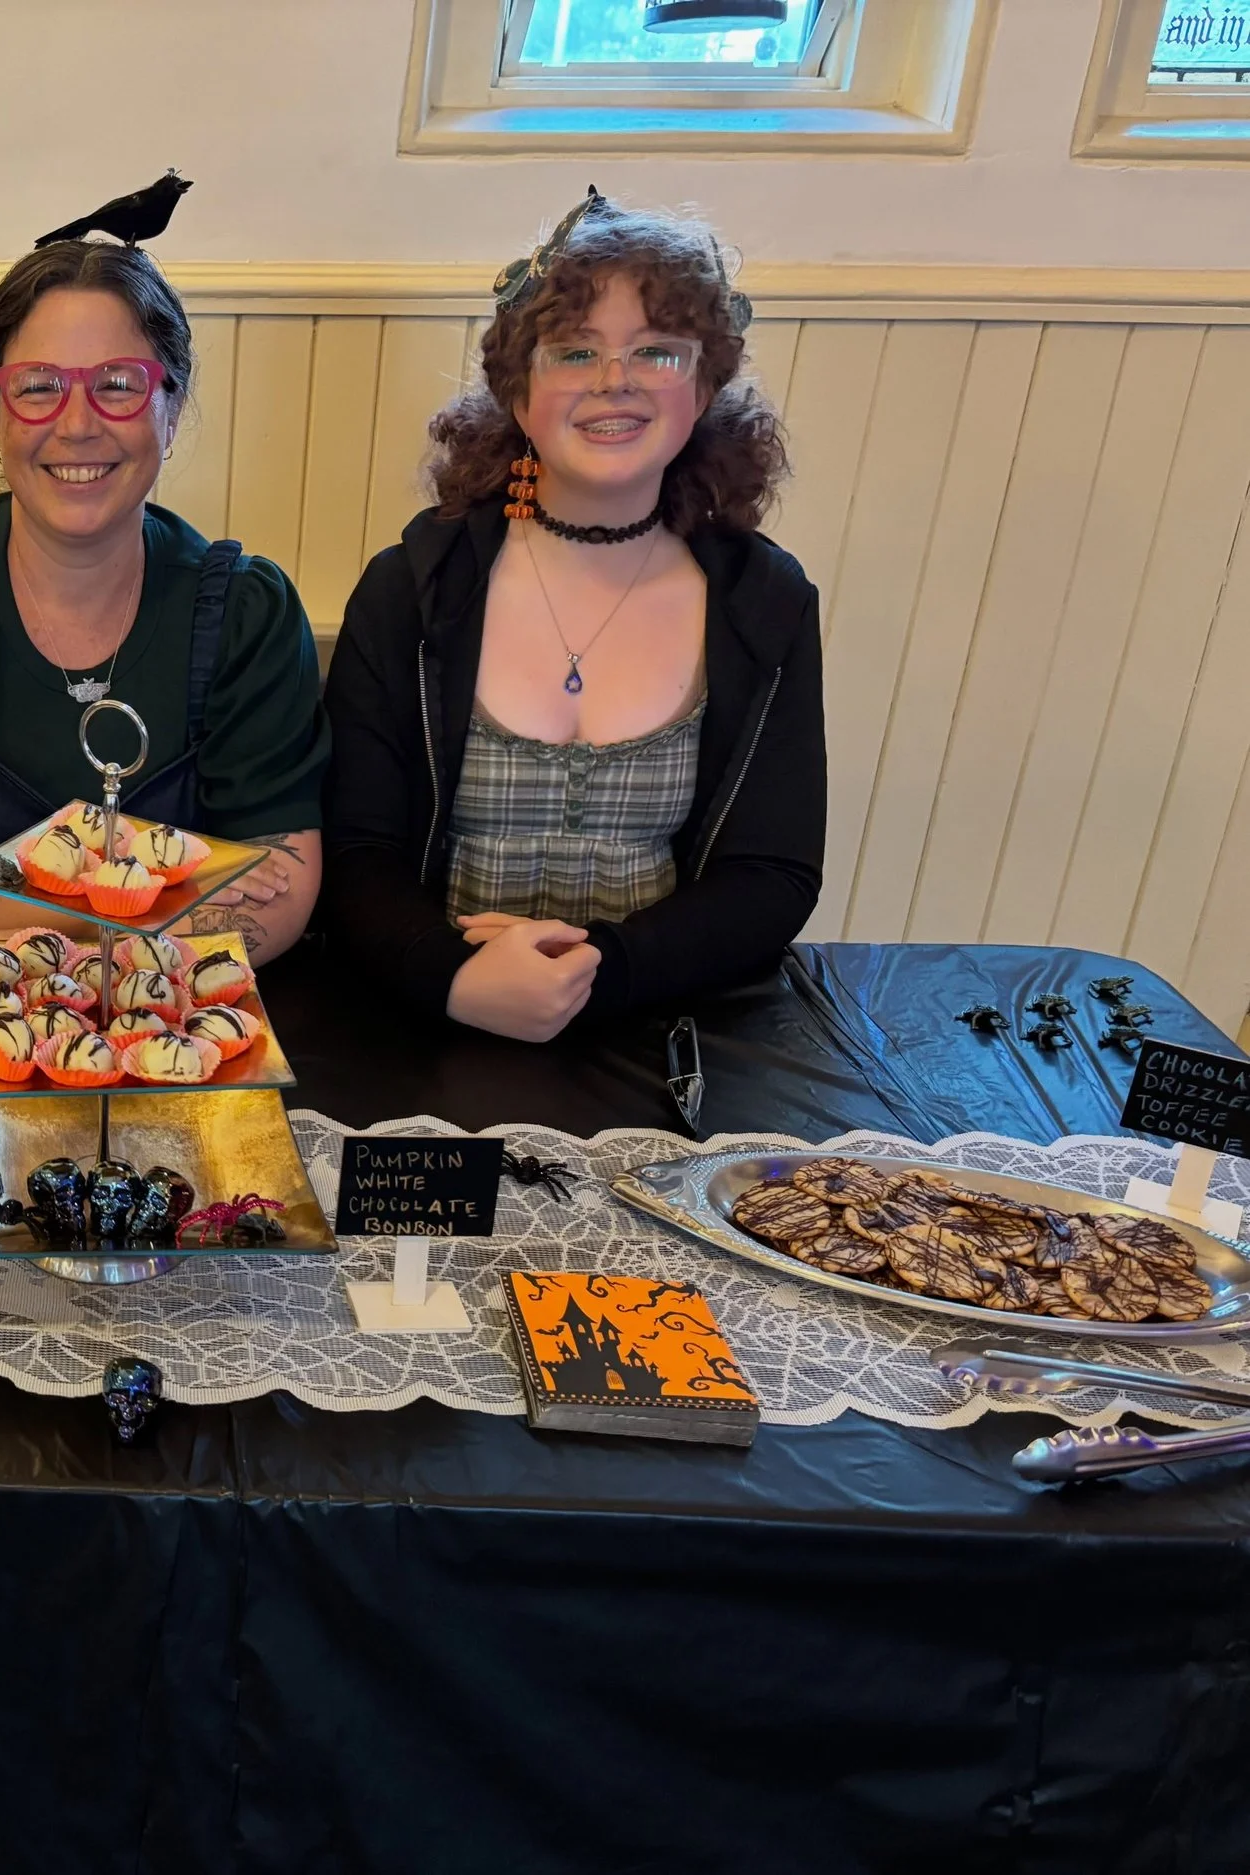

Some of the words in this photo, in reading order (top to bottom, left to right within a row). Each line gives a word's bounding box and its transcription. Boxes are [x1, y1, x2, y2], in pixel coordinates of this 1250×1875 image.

[1165, 6, 1215, 52] and
[1218, 7, 1245, 52] in
[1145, 1051, 1250, 1090] CHOCOLA
[1143, 1072, 1250, 1111] DRIZZLE
[1136, 1094, 1228, 1127] TOFFEE
[1141, 1114, 1245, 1155] COOKIE
[355, 1144, 463, 1170] PUMPKIN
[355, 1173, 426, 1191] WHITE
[349, 1196, 479, 1218] CHOCOLATE
[364, 1217, 454, 1236] BONBON
